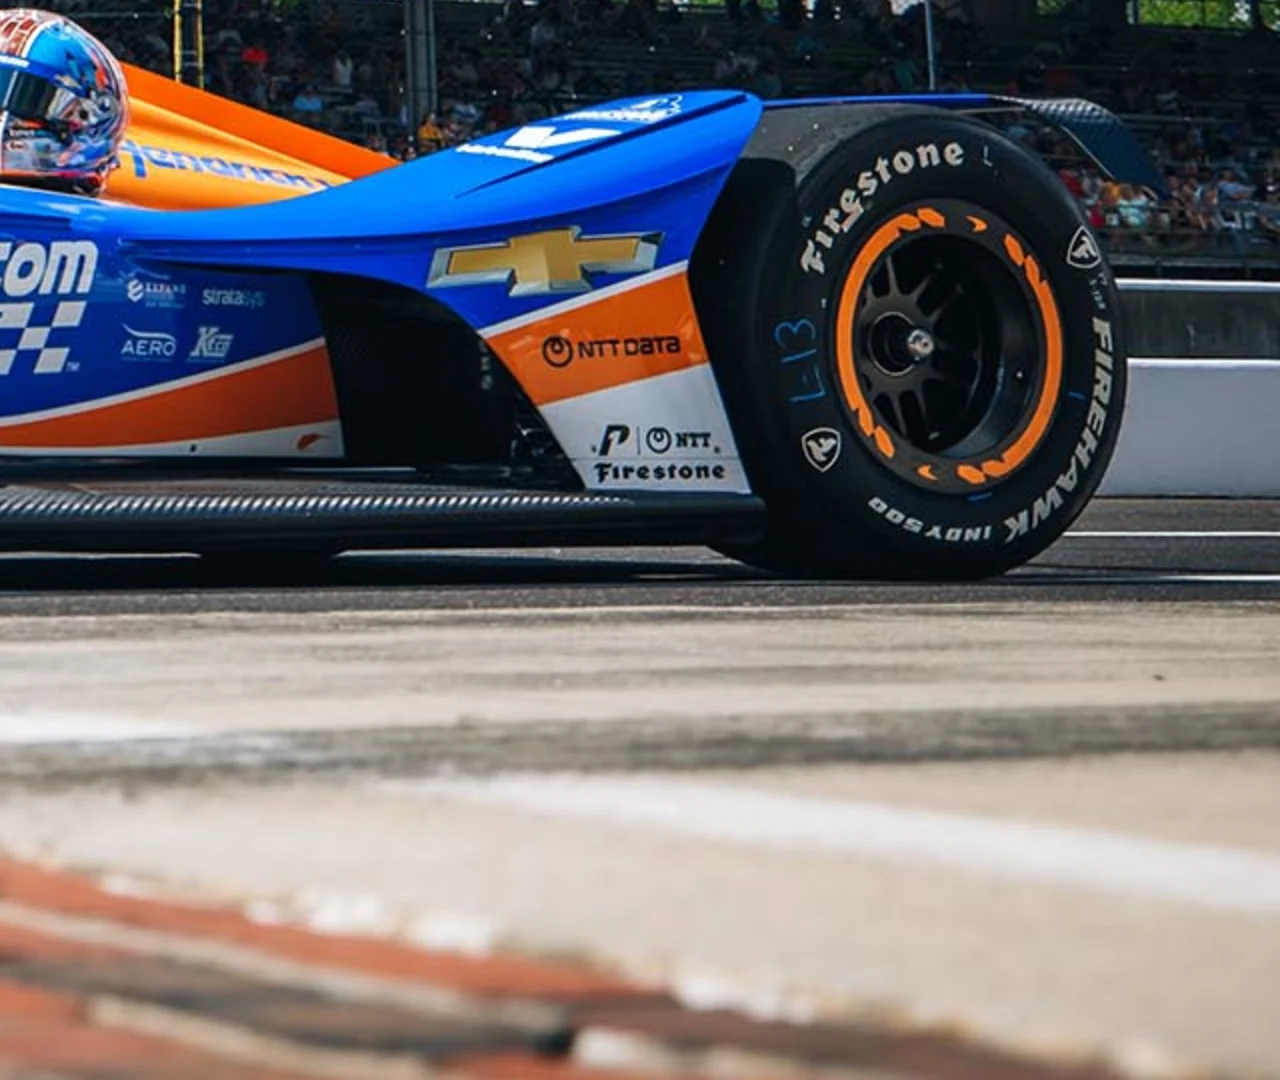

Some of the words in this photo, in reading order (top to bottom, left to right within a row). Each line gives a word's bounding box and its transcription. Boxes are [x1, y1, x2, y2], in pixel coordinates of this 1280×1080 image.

[800, 140, 965, 276] Firestone
[120, 338, 177, 357] AERO
[578, 339, 619, 359] NTT
[675, 431, 712, 448] NTT
[1003, 315, 1113, 544] FIREHAWK
[593, 462, 726, 484] Firestone
